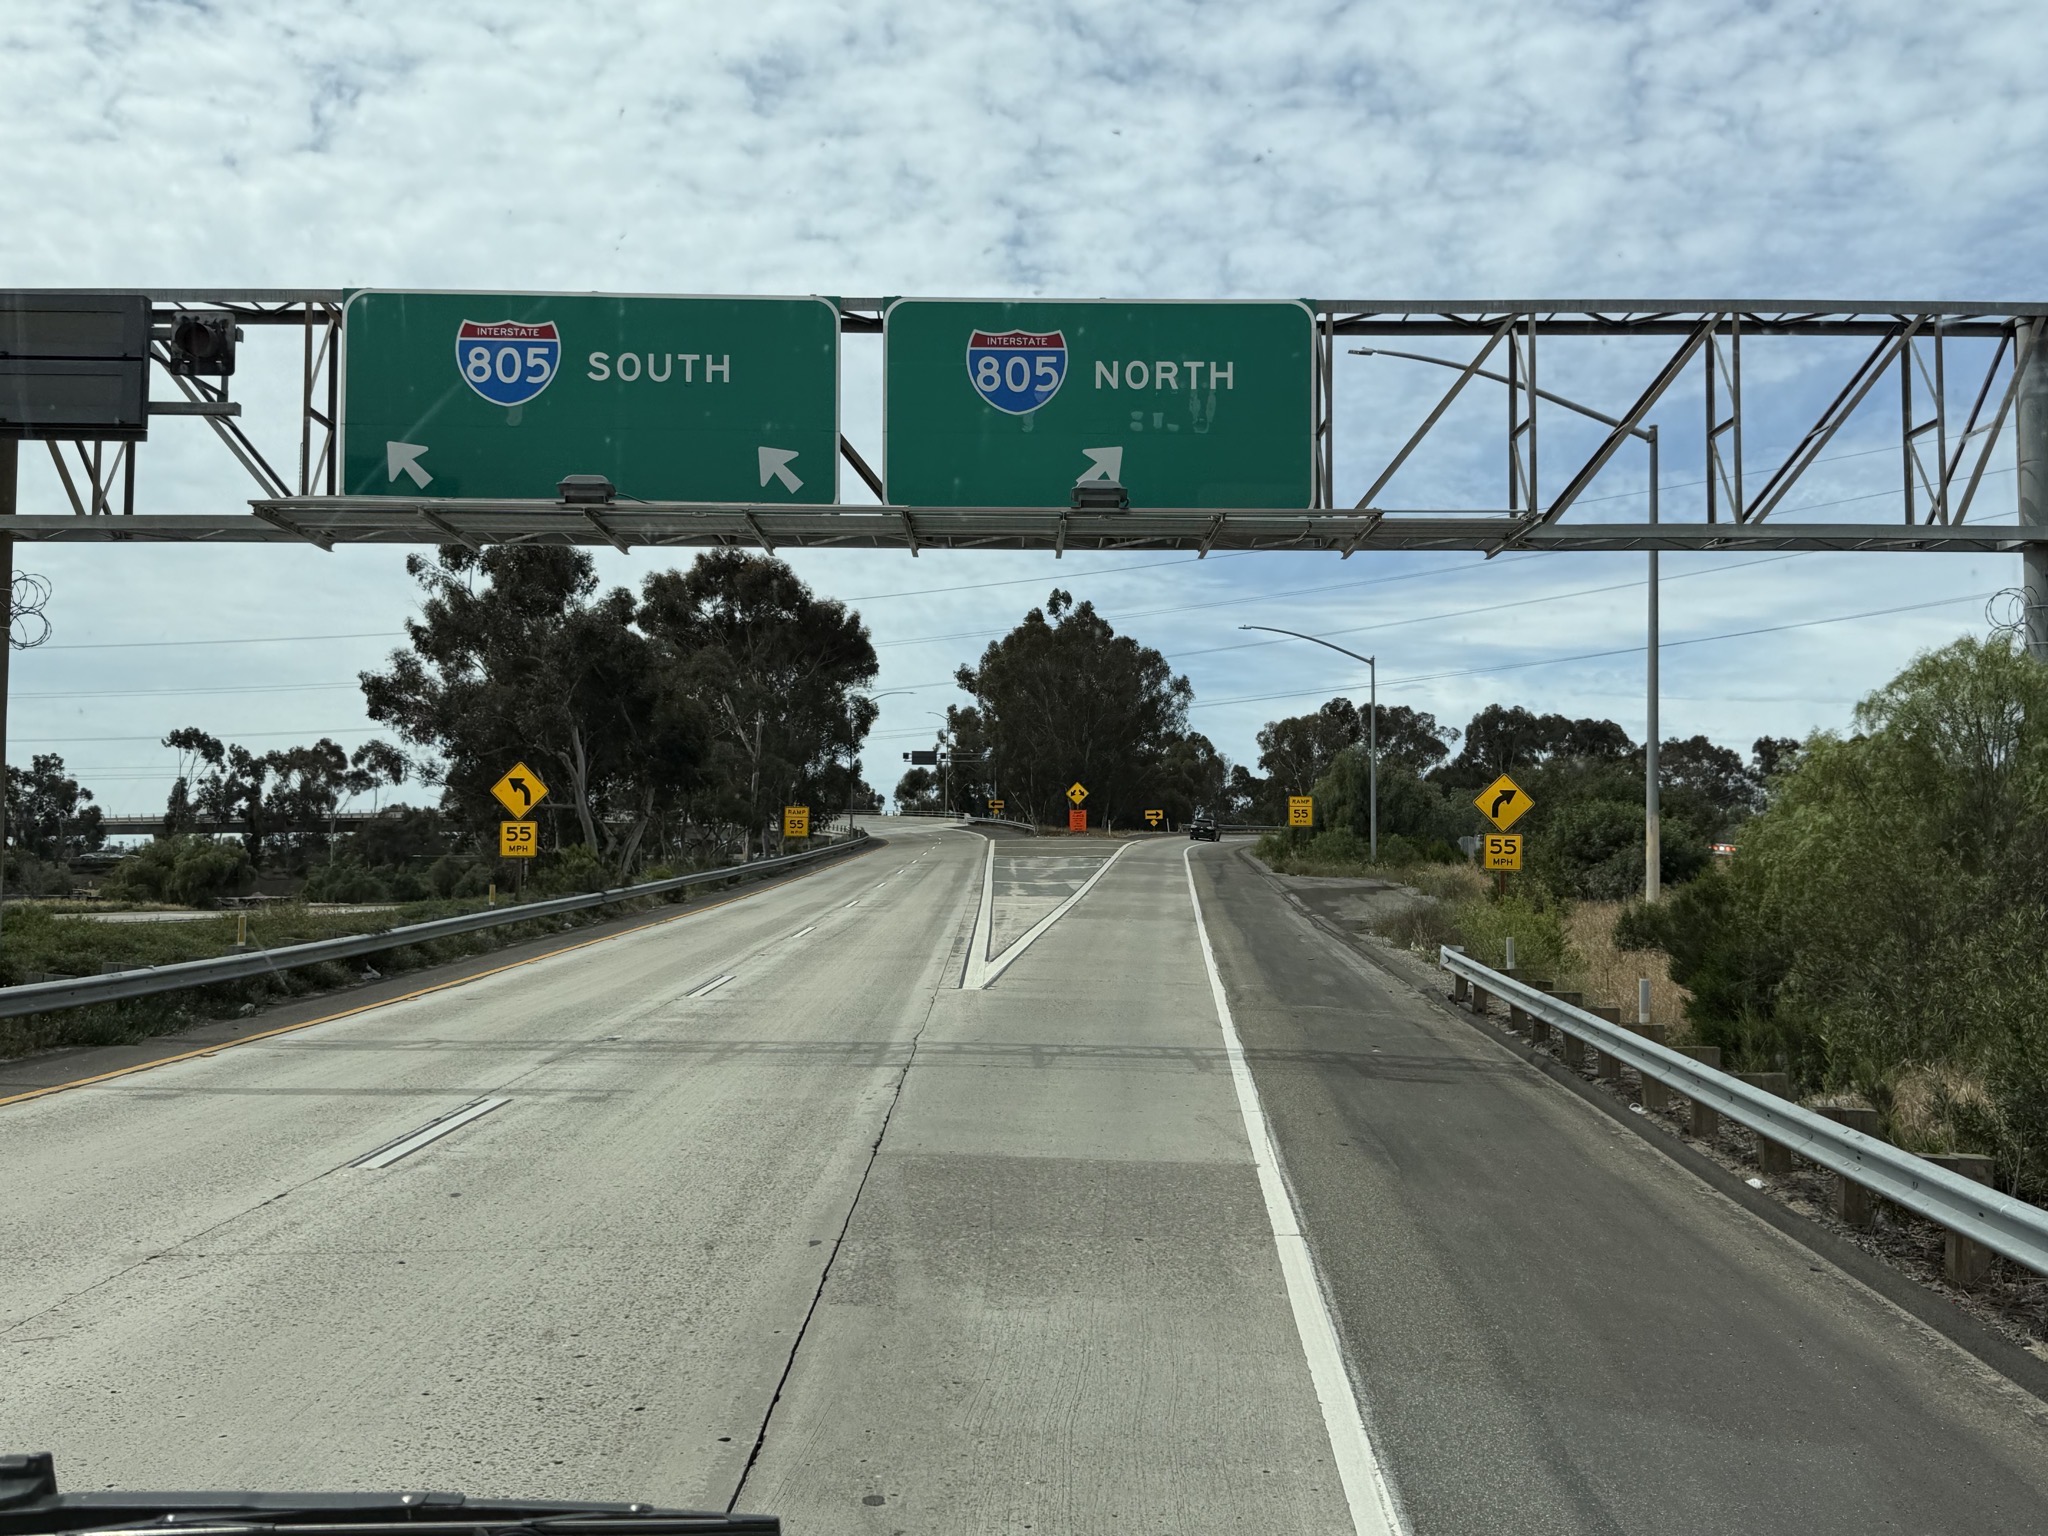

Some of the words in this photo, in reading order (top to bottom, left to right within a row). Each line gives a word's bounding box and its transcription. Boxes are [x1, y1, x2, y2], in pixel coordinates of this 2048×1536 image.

[477, 327, 540, 337] INTERSTATE
[987, 337, 1048, 346] INTERSTATE
[466, 346, 551, 384] 805
[586, 351, 730, 383] SOUTH
[976, 355, 1059, 393] 805
[1095, 360, 1234, 390] NORTH
[1293, 809, 1309, 818] 55
[789, 819, 804, 829] 55
[506, 826, 532, 842] 55
[1490, 839, 1517, 855] 55
[1493, 858, 1513, 866] MPH
